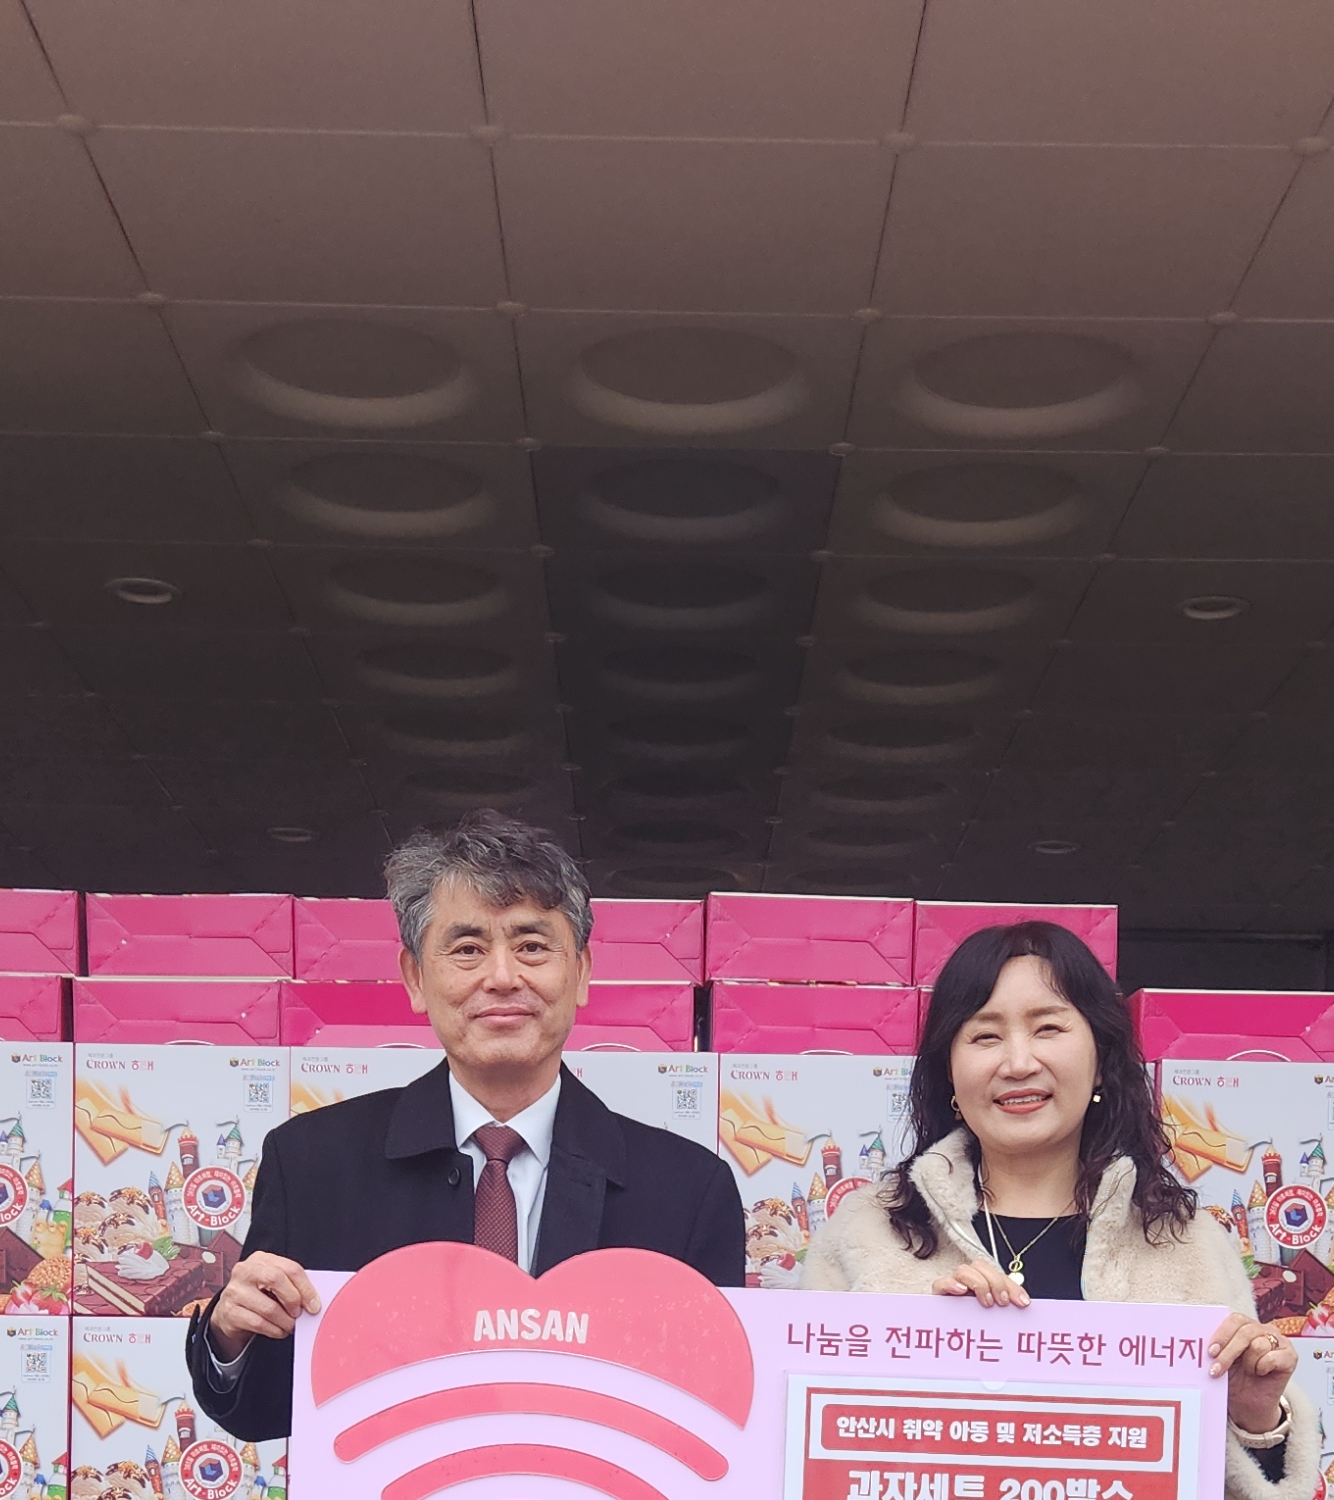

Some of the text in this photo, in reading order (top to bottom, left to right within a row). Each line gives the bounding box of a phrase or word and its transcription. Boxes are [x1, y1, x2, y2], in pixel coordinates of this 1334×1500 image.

[86, 1059, 125, 1069] CROWN
[239, 1057, 280, 1066] Art Block
[300, 1062, 340, 1072] CROWN
[668, 1064, 708, 1072] Art Block
[883, 1067, 898, 1075] Art
[730, 1069, 770, 1079] CROWN
[1172, 1075, 1211, 1085] CROWN
[473, 1308, 590, 1345] ANSAN
[83, 1332, 122, 1342] CROWN
[786, 1323, 1205, 1368] 나눔을 전파하는 따뜻한 에너지
[835, 1416, 1148, 1449] 안산시 취약 아동 및 저소득층 지원
